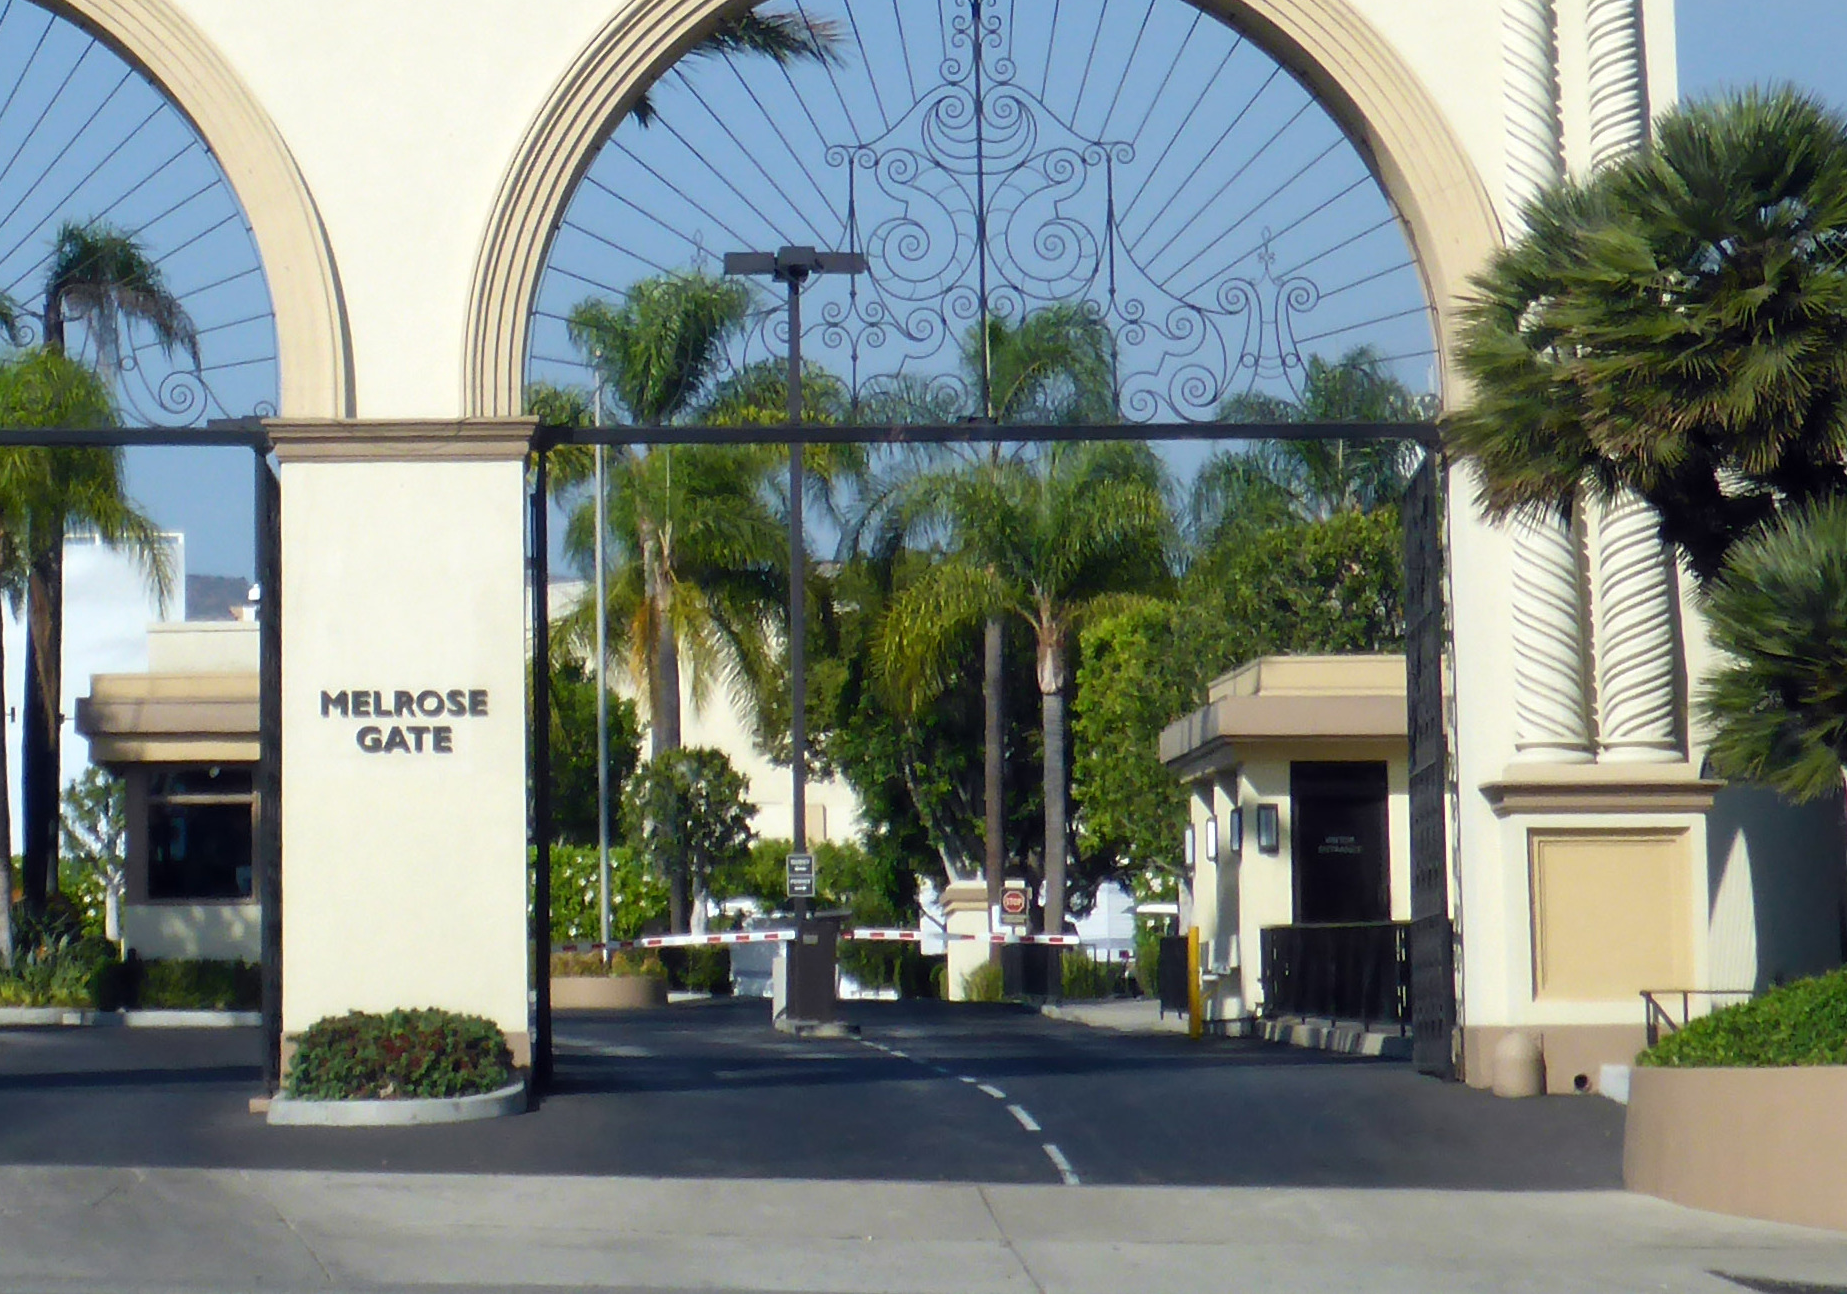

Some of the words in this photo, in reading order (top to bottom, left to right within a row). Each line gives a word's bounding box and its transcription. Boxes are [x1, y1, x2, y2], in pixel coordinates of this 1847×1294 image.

[319, 689, 489, 718] MELROSE
[355, 725, 454, 754] GATE
[1006, 897, 1022, 906] STOP
